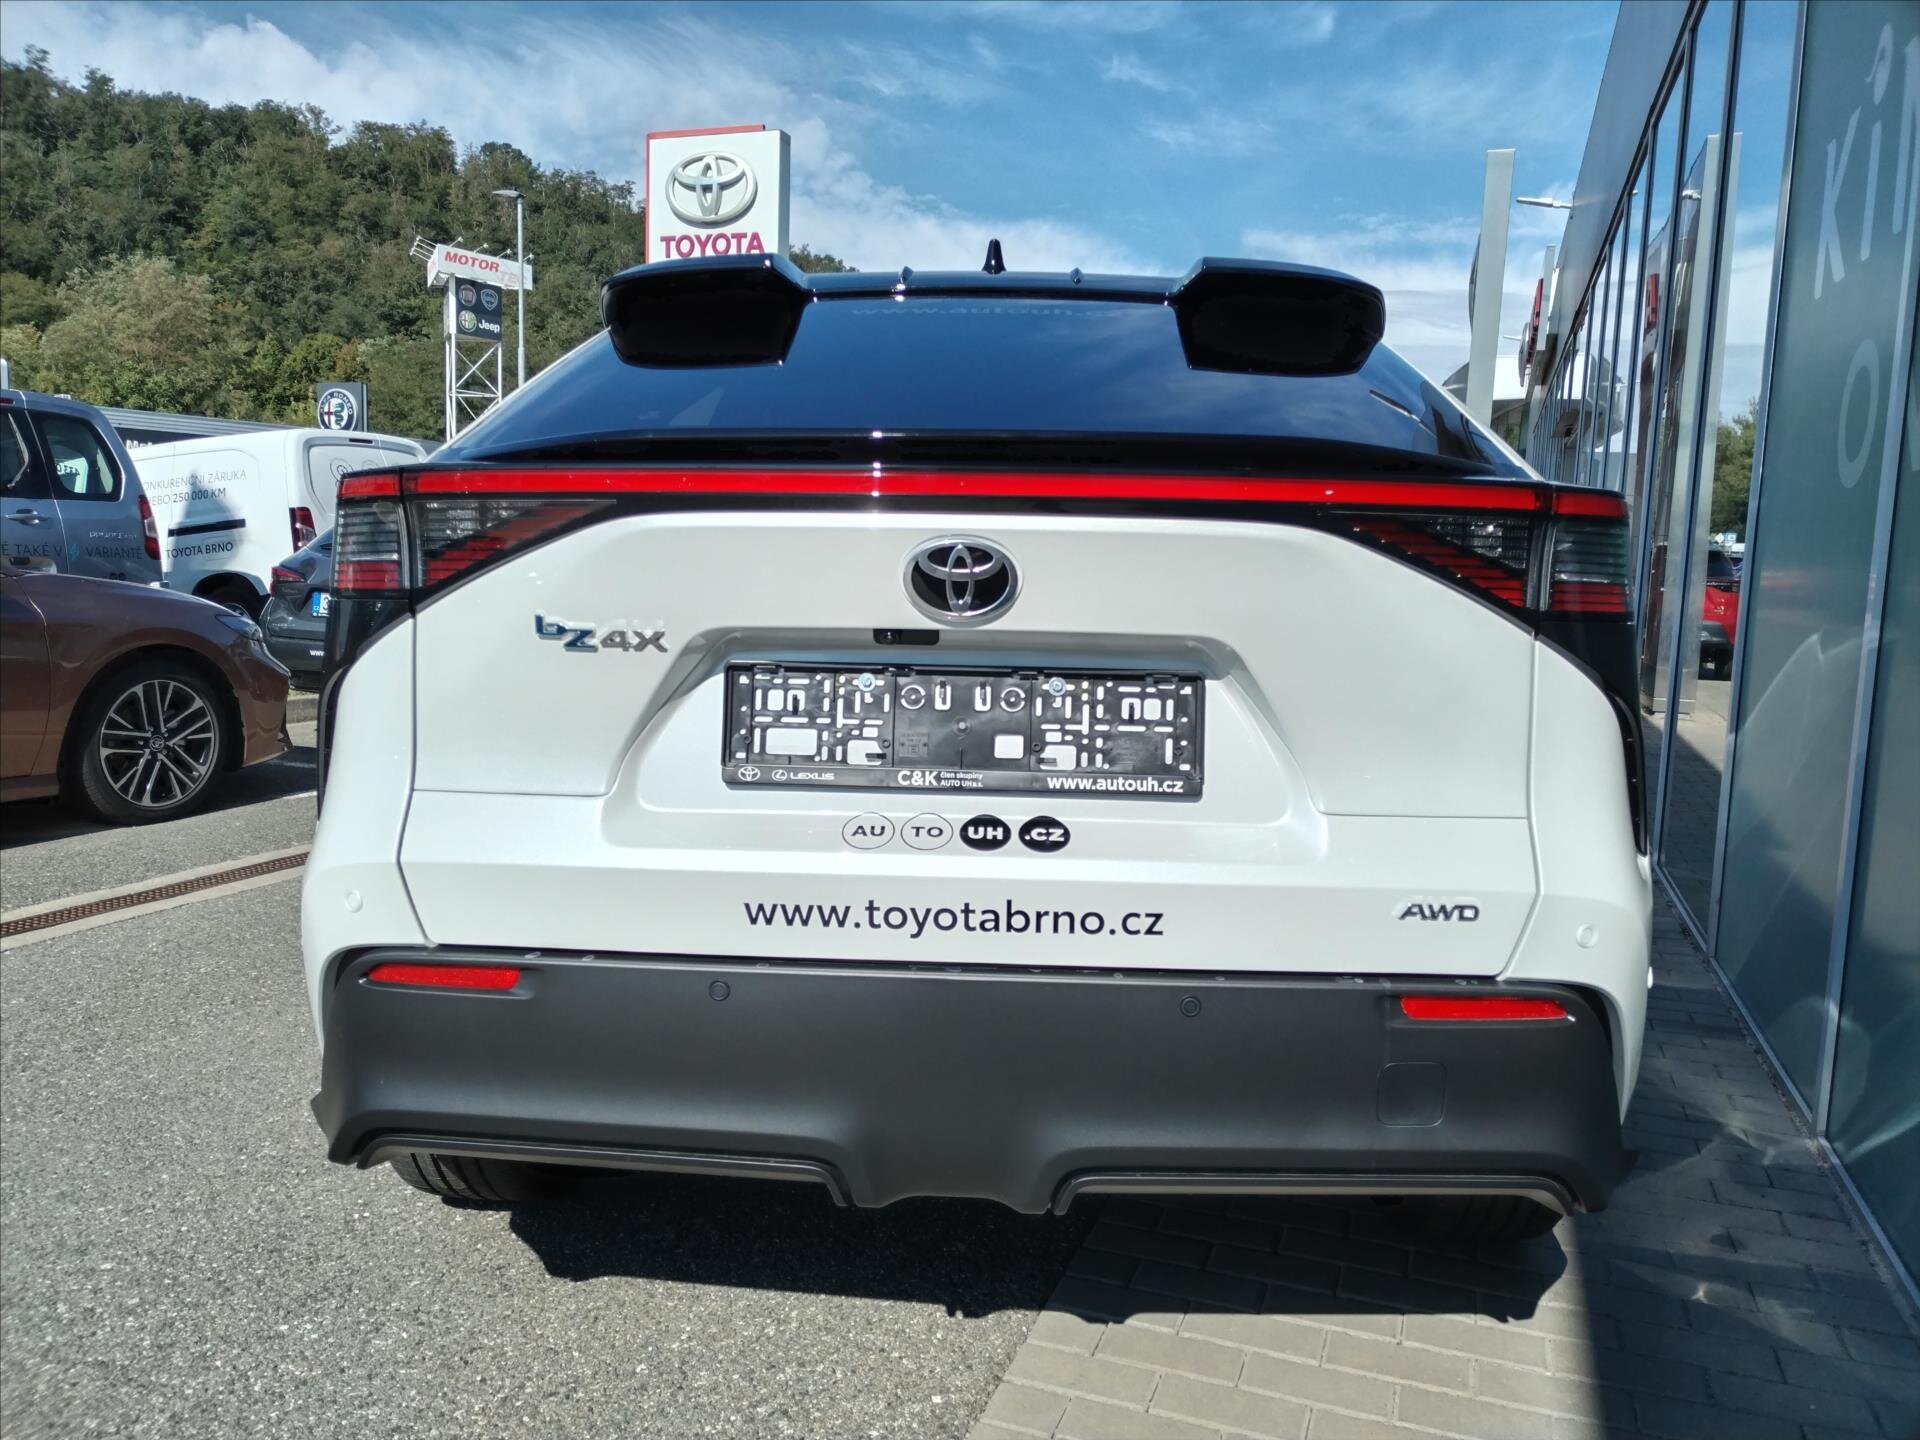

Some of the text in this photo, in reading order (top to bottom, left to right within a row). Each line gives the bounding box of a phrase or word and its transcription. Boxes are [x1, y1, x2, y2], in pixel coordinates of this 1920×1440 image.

[660, 232, 765, 259] TOYOTA
[444, 251, 500, 272] MOTOR
[478, 319, 501, 334] Jeep
[149, 487, 226, 506] EBO 250 000 KM
[166, 541, 234, 559] TOYOTA BRNO
[790, 770, 938, 786] LEXUS C&K
[940, 779, 960, 787] AUTO
[956, 772, 984, 781] skupiny
[1047, 776, 1184, 793] www.autouh.cz
[851, 825, 886, 838] AU
[911, 826, 943, 838] TO
[967, 827, 1004, 840] UH
[744, 899, 1165, 938] www.toyotabrno.cz
[1398, 903, 1480, 921] AWD
